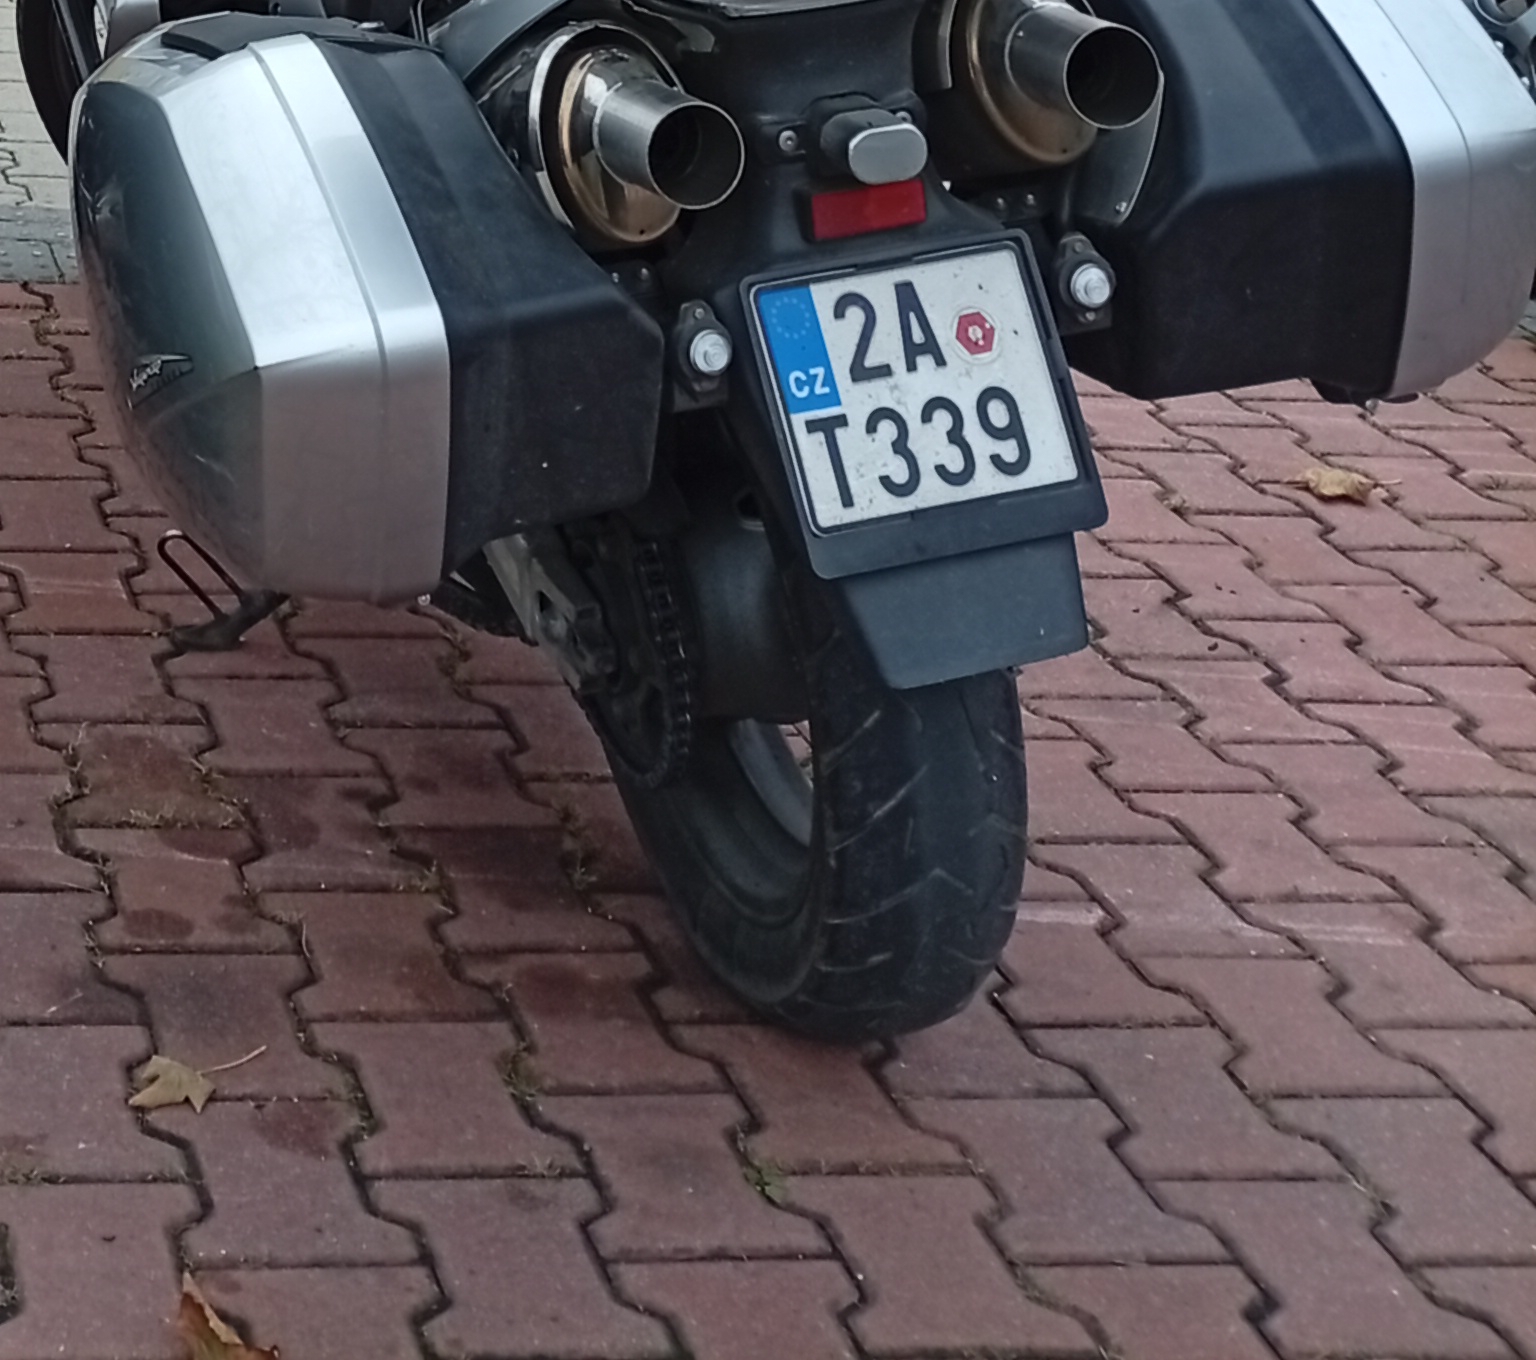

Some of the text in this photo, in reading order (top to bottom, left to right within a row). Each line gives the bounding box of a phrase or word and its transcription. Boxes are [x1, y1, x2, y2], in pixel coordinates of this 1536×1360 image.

[787, 367, 830, 399] CZ
[833, 280, 947, 384] 2A
[805, 385, 1032, 509] T339
